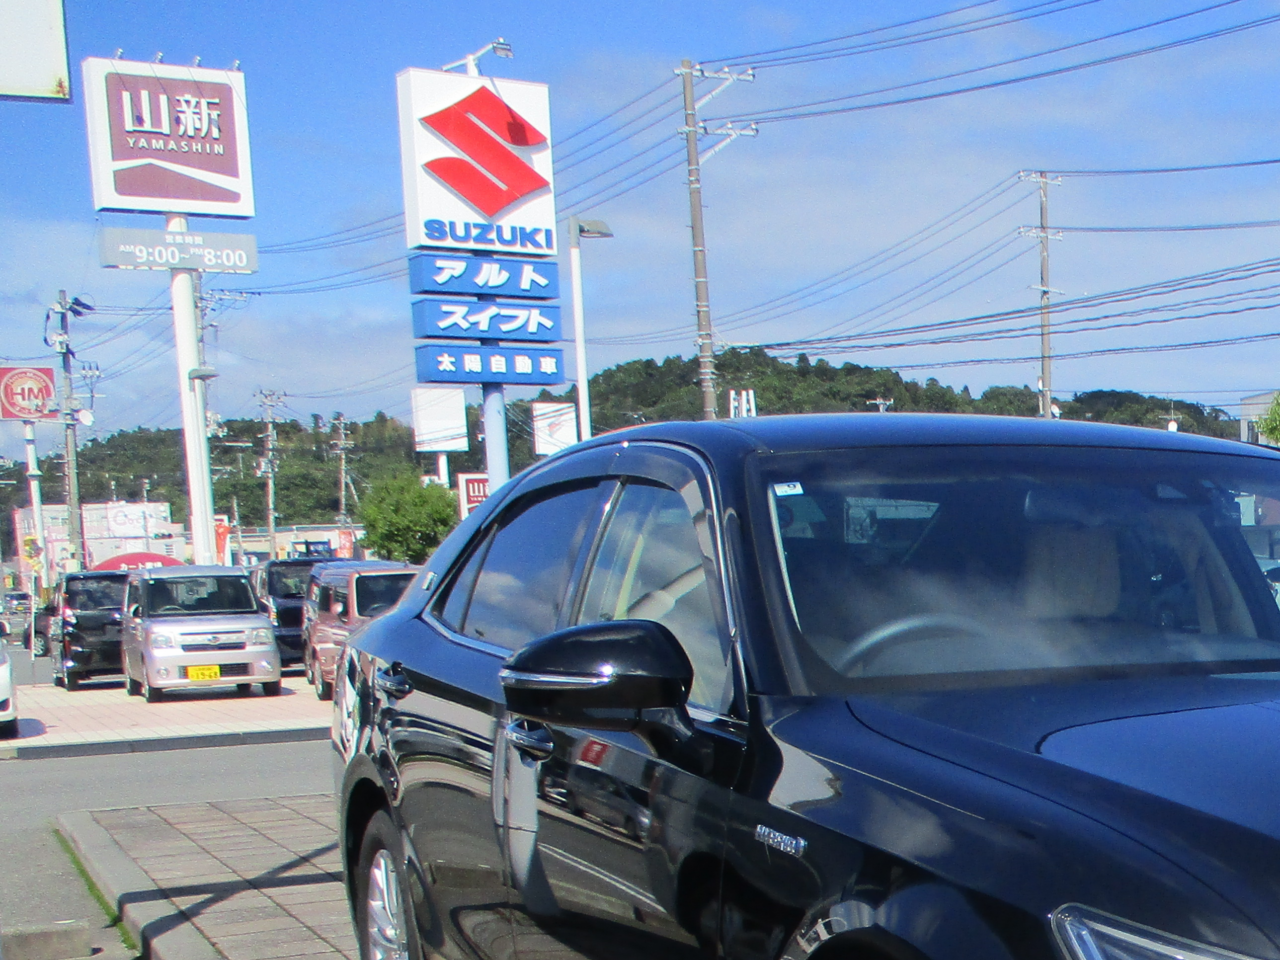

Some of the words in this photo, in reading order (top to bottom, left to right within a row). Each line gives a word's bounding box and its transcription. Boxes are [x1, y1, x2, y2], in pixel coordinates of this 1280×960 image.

[121, 89, 221, 140] 山新
[126, 137, 225, 156] YAMASHIN
[423, 218, 555, 250] SUZUKI
[432, 259, 550, 291] アルト
[436, 304, 555, 334] スイフト
[436, 353, 558, 375] 太陽自動車
